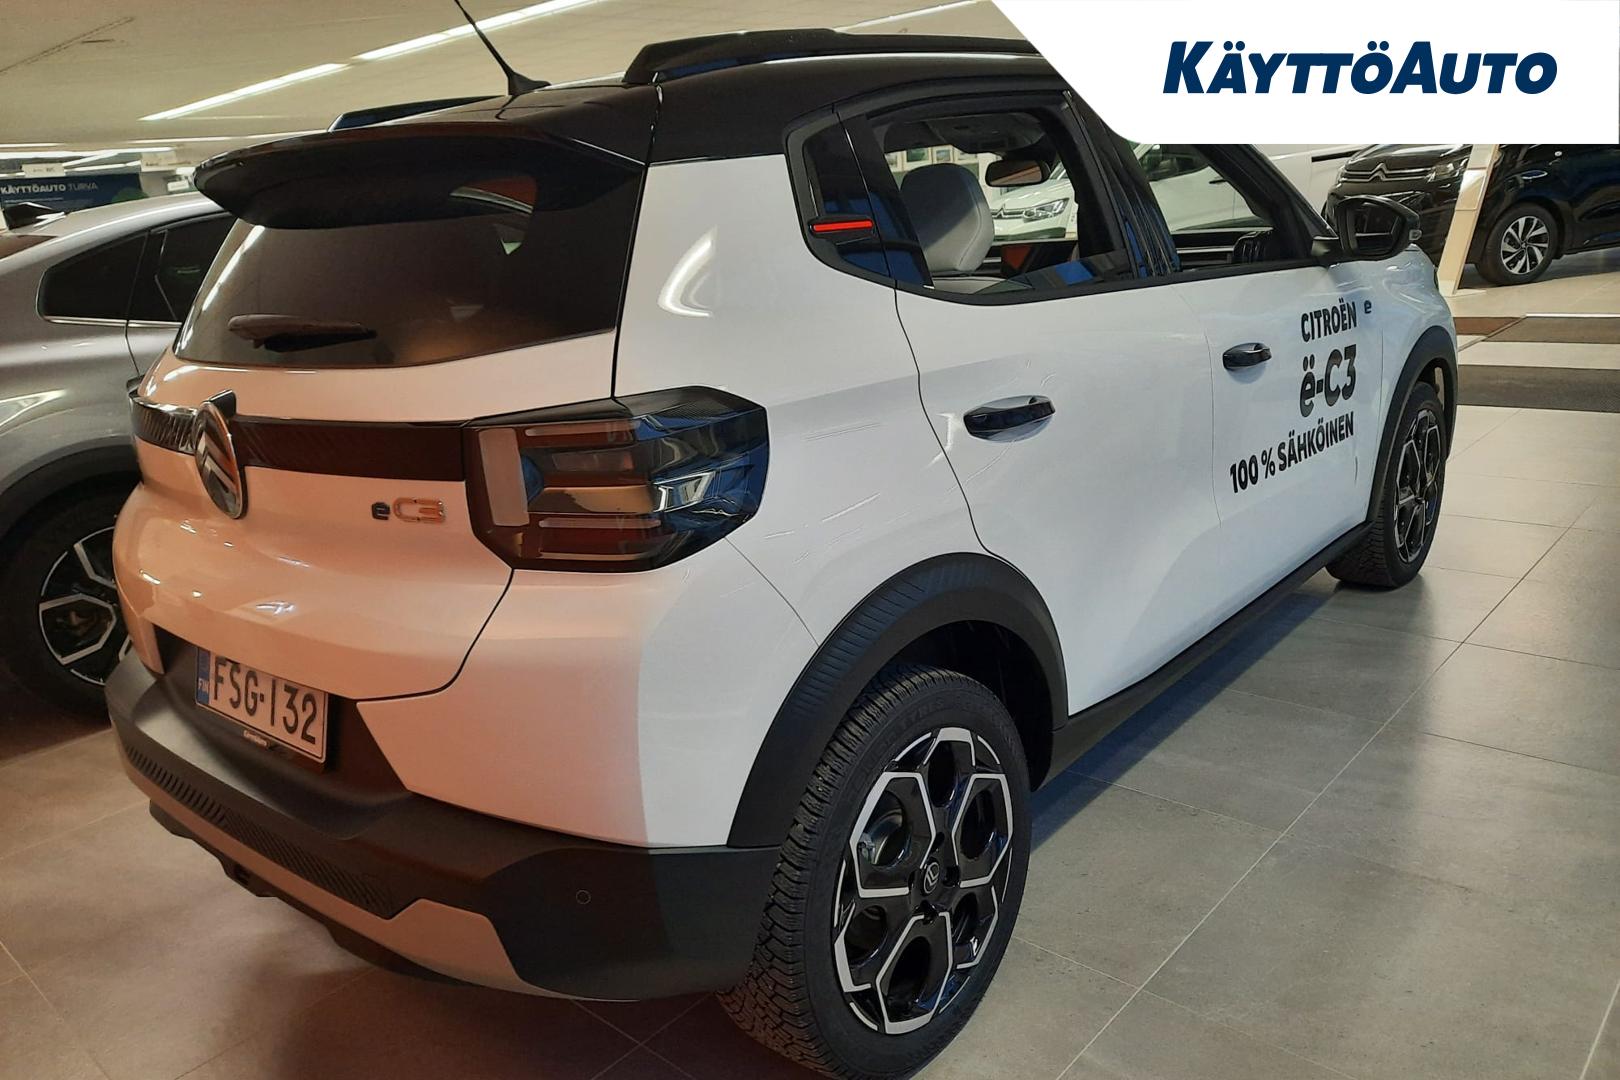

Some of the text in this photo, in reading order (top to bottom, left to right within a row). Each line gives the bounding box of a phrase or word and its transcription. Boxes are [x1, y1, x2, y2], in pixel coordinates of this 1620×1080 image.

[1301, 298, 1357, 342] CITROËN
[1300, 344, 1357, 417] ë-C3
[1230, 411, 1354, 493] 100 % SÄHKÖINEN
[214, 656, 316, 744] FSG-132
